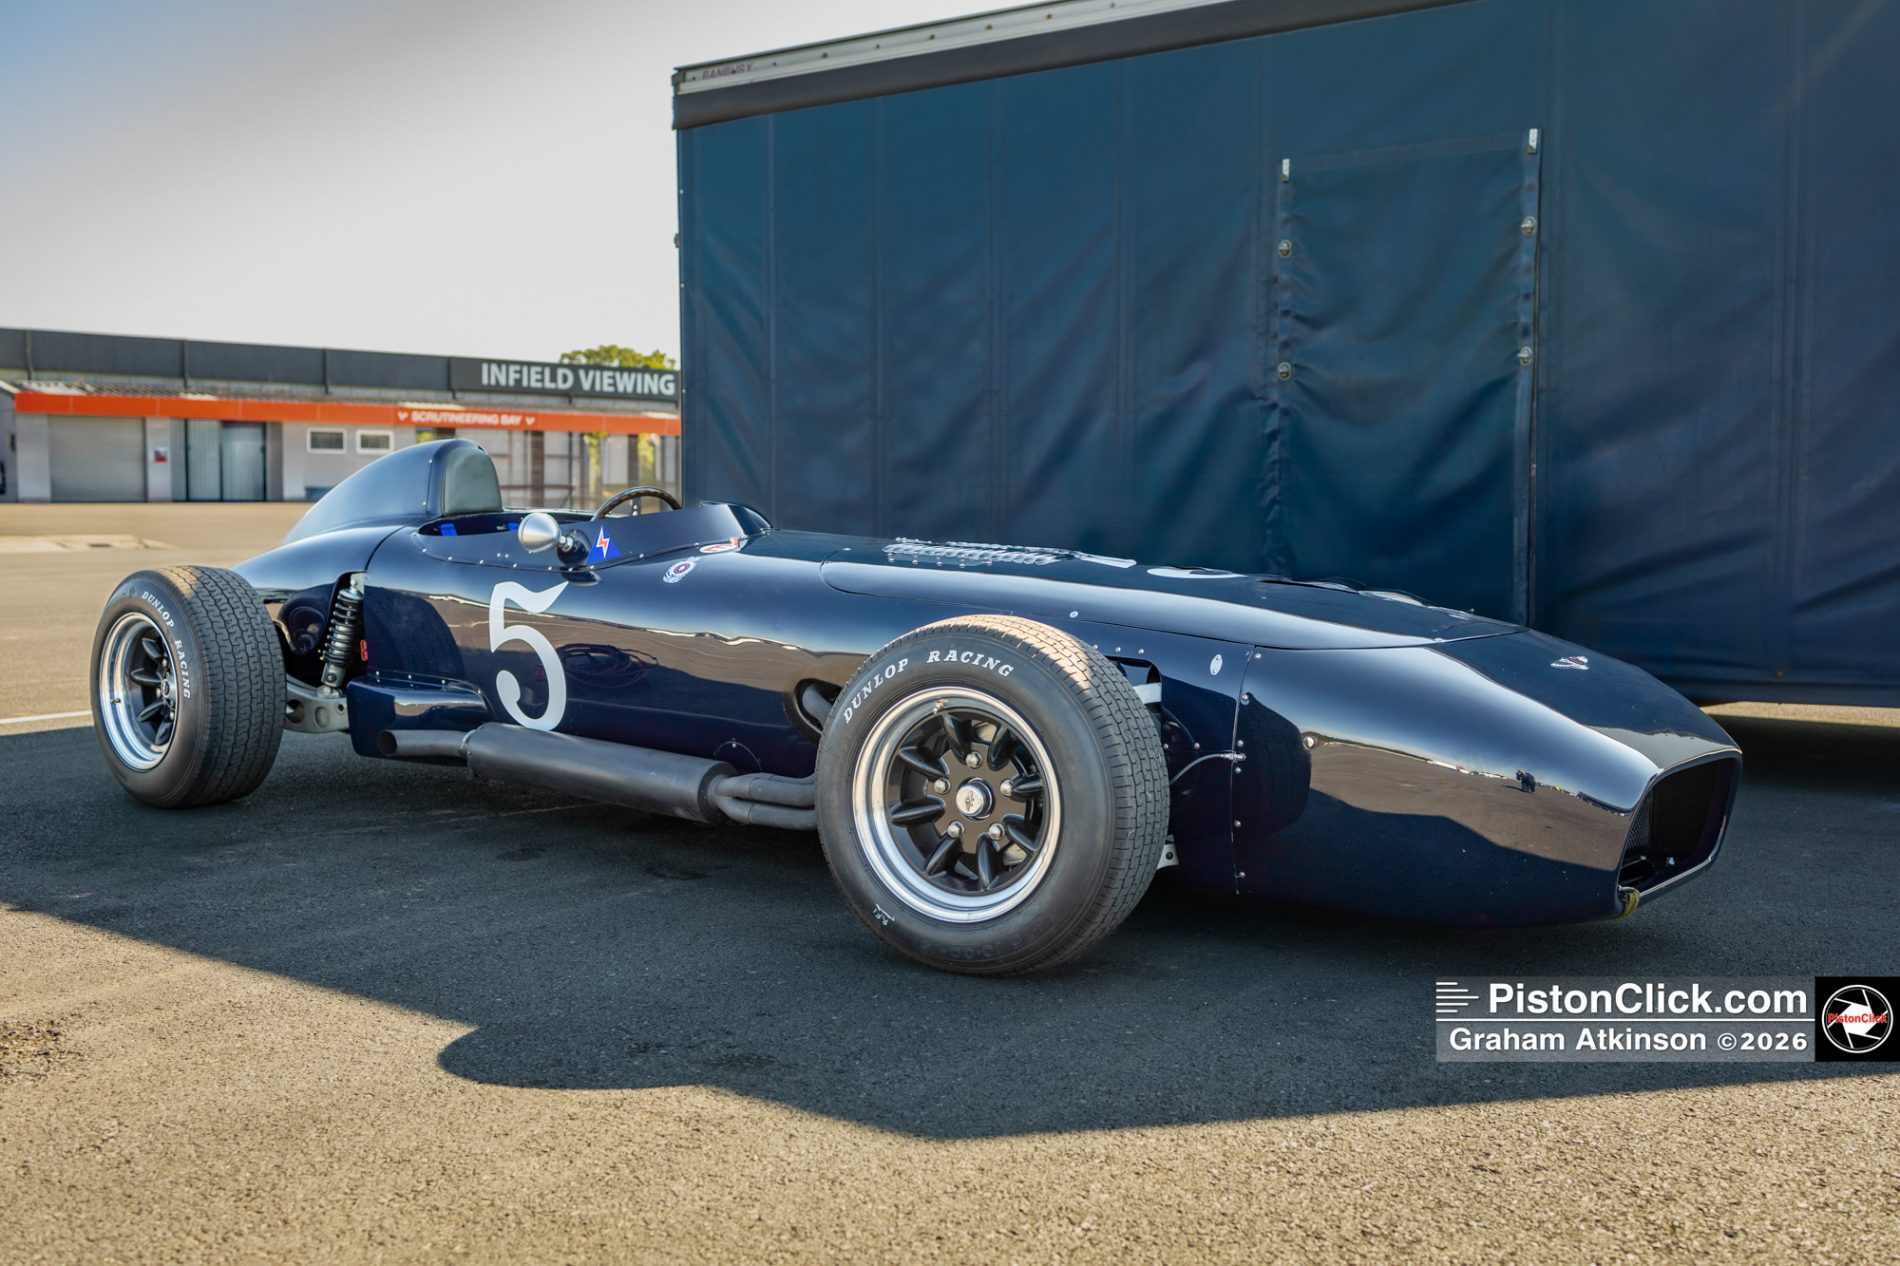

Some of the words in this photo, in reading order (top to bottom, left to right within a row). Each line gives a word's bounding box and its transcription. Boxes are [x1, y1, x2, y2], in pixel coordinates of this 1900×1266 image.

[481, 362, 575, 390] INFIELD
[578, 369, 676, 396] VIEWING
[411, 411, 499, 425] SCRUTINEERING
[501, 414, 522, 426] BAY
[141, 591, 175, 628] DUNLOP
[174, 639, 191, 699] RACING
[489, 580, 569, 731] 5
[842, 658, 909, 725] DUNLOP
[926, 650, 1014, 677] RACING
